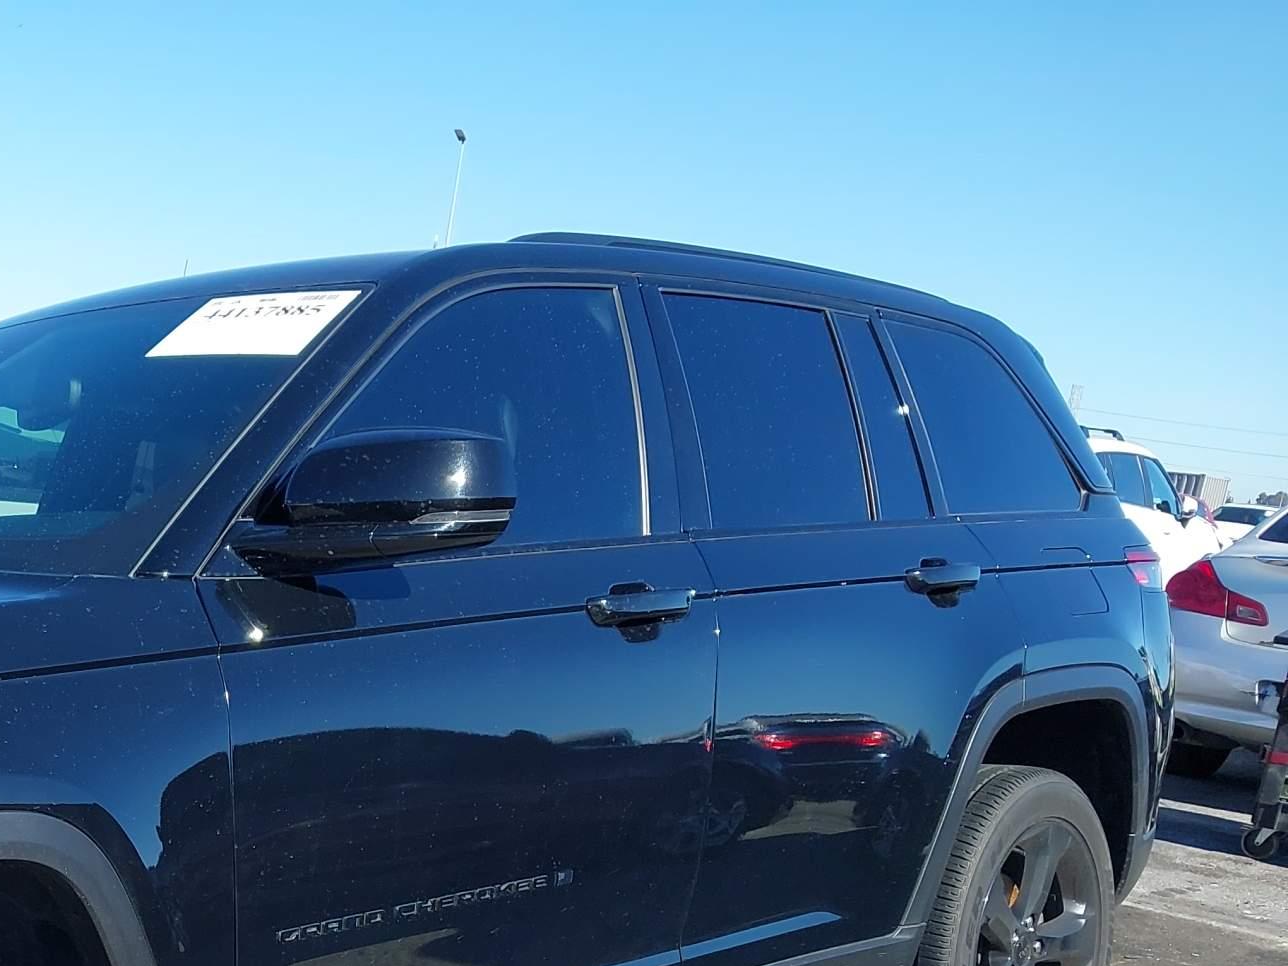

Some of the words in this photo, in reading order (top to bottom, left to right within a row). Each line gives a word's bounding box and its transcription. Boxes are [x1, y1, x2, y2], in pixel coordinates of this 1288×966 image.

[203, 303, 326, 319] 44137885
[276, 908, 386, 944] GRAND
[393, 875, 549, 920] CHEROKEE
